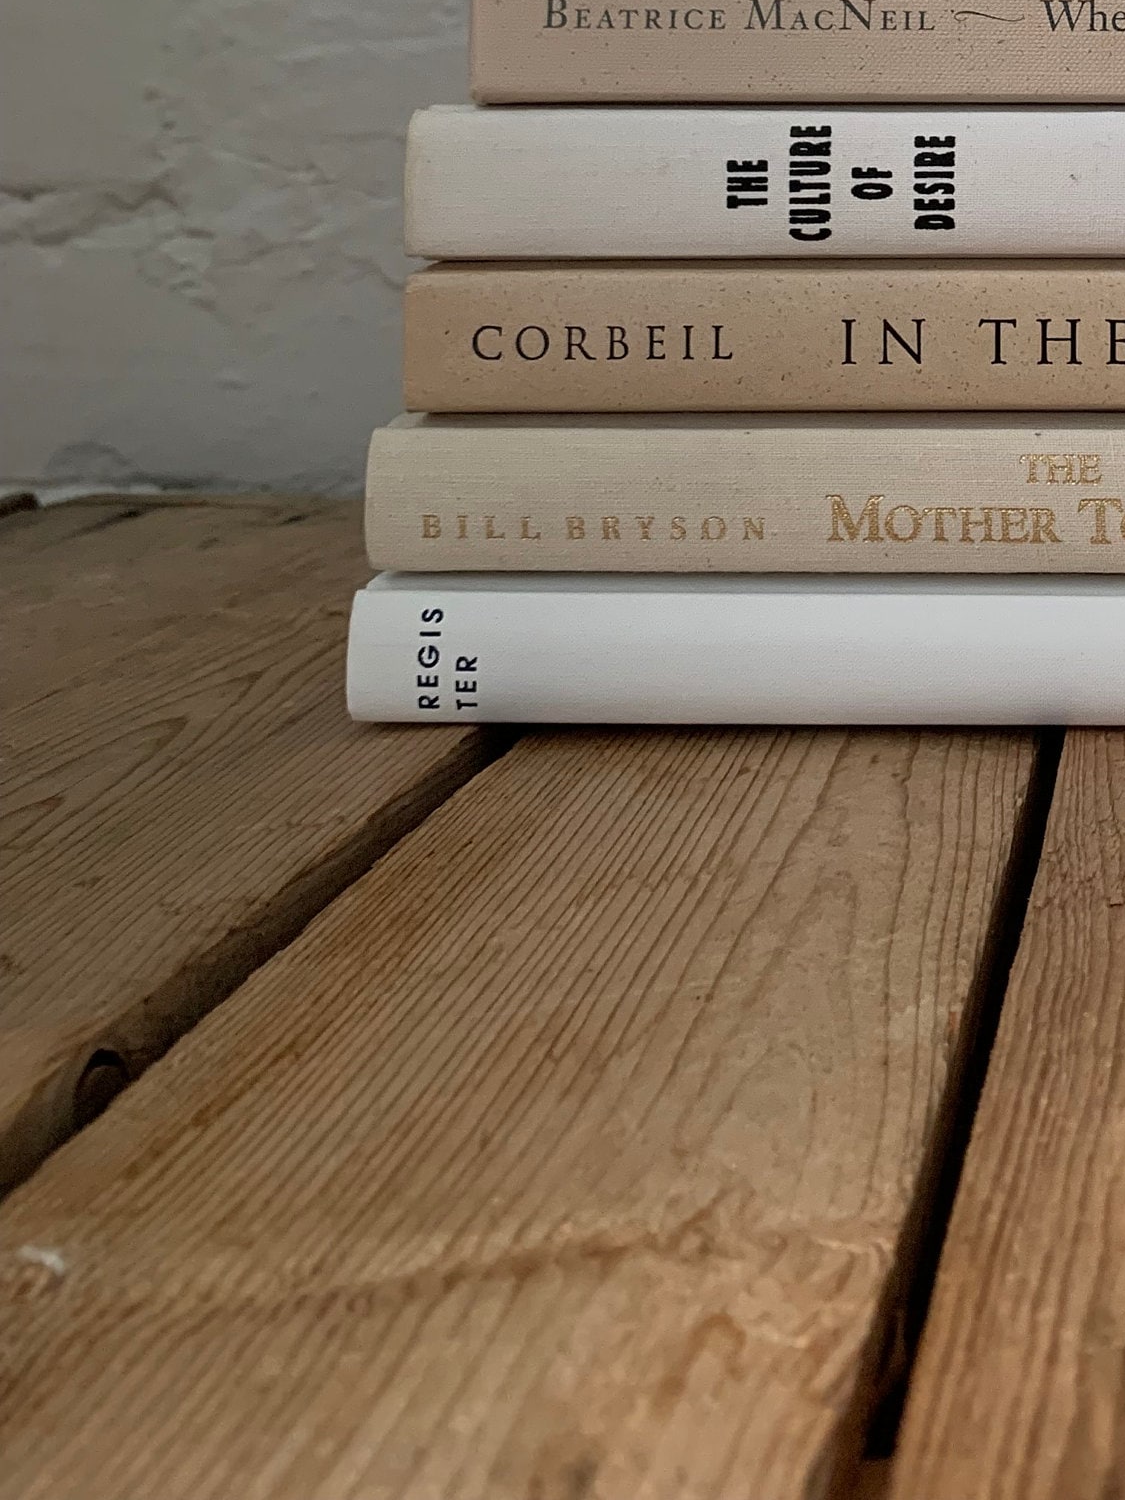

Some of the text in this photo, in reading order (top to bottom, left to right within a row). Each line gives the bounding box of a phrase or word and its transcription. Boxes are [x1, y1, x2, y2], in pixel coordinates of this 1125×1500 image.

[726, 159, 769, 209] THE
[789, 125, 832, 241] CULTURE
[851, 166, 894, 200] OF
[914, 135, 957, 231] DESIRE
[471, 324, 734, 362] CORBEIL
[840, 317, 926, 366] IN
[1019, 453, 1103, 486] THE
[421, 514, 767, 543] BILL BRYSON
[825, 494, 1062, 544] MOTHER
[417, 607, 444, 710] REGIS
[455, 654, 479, 710] TER
